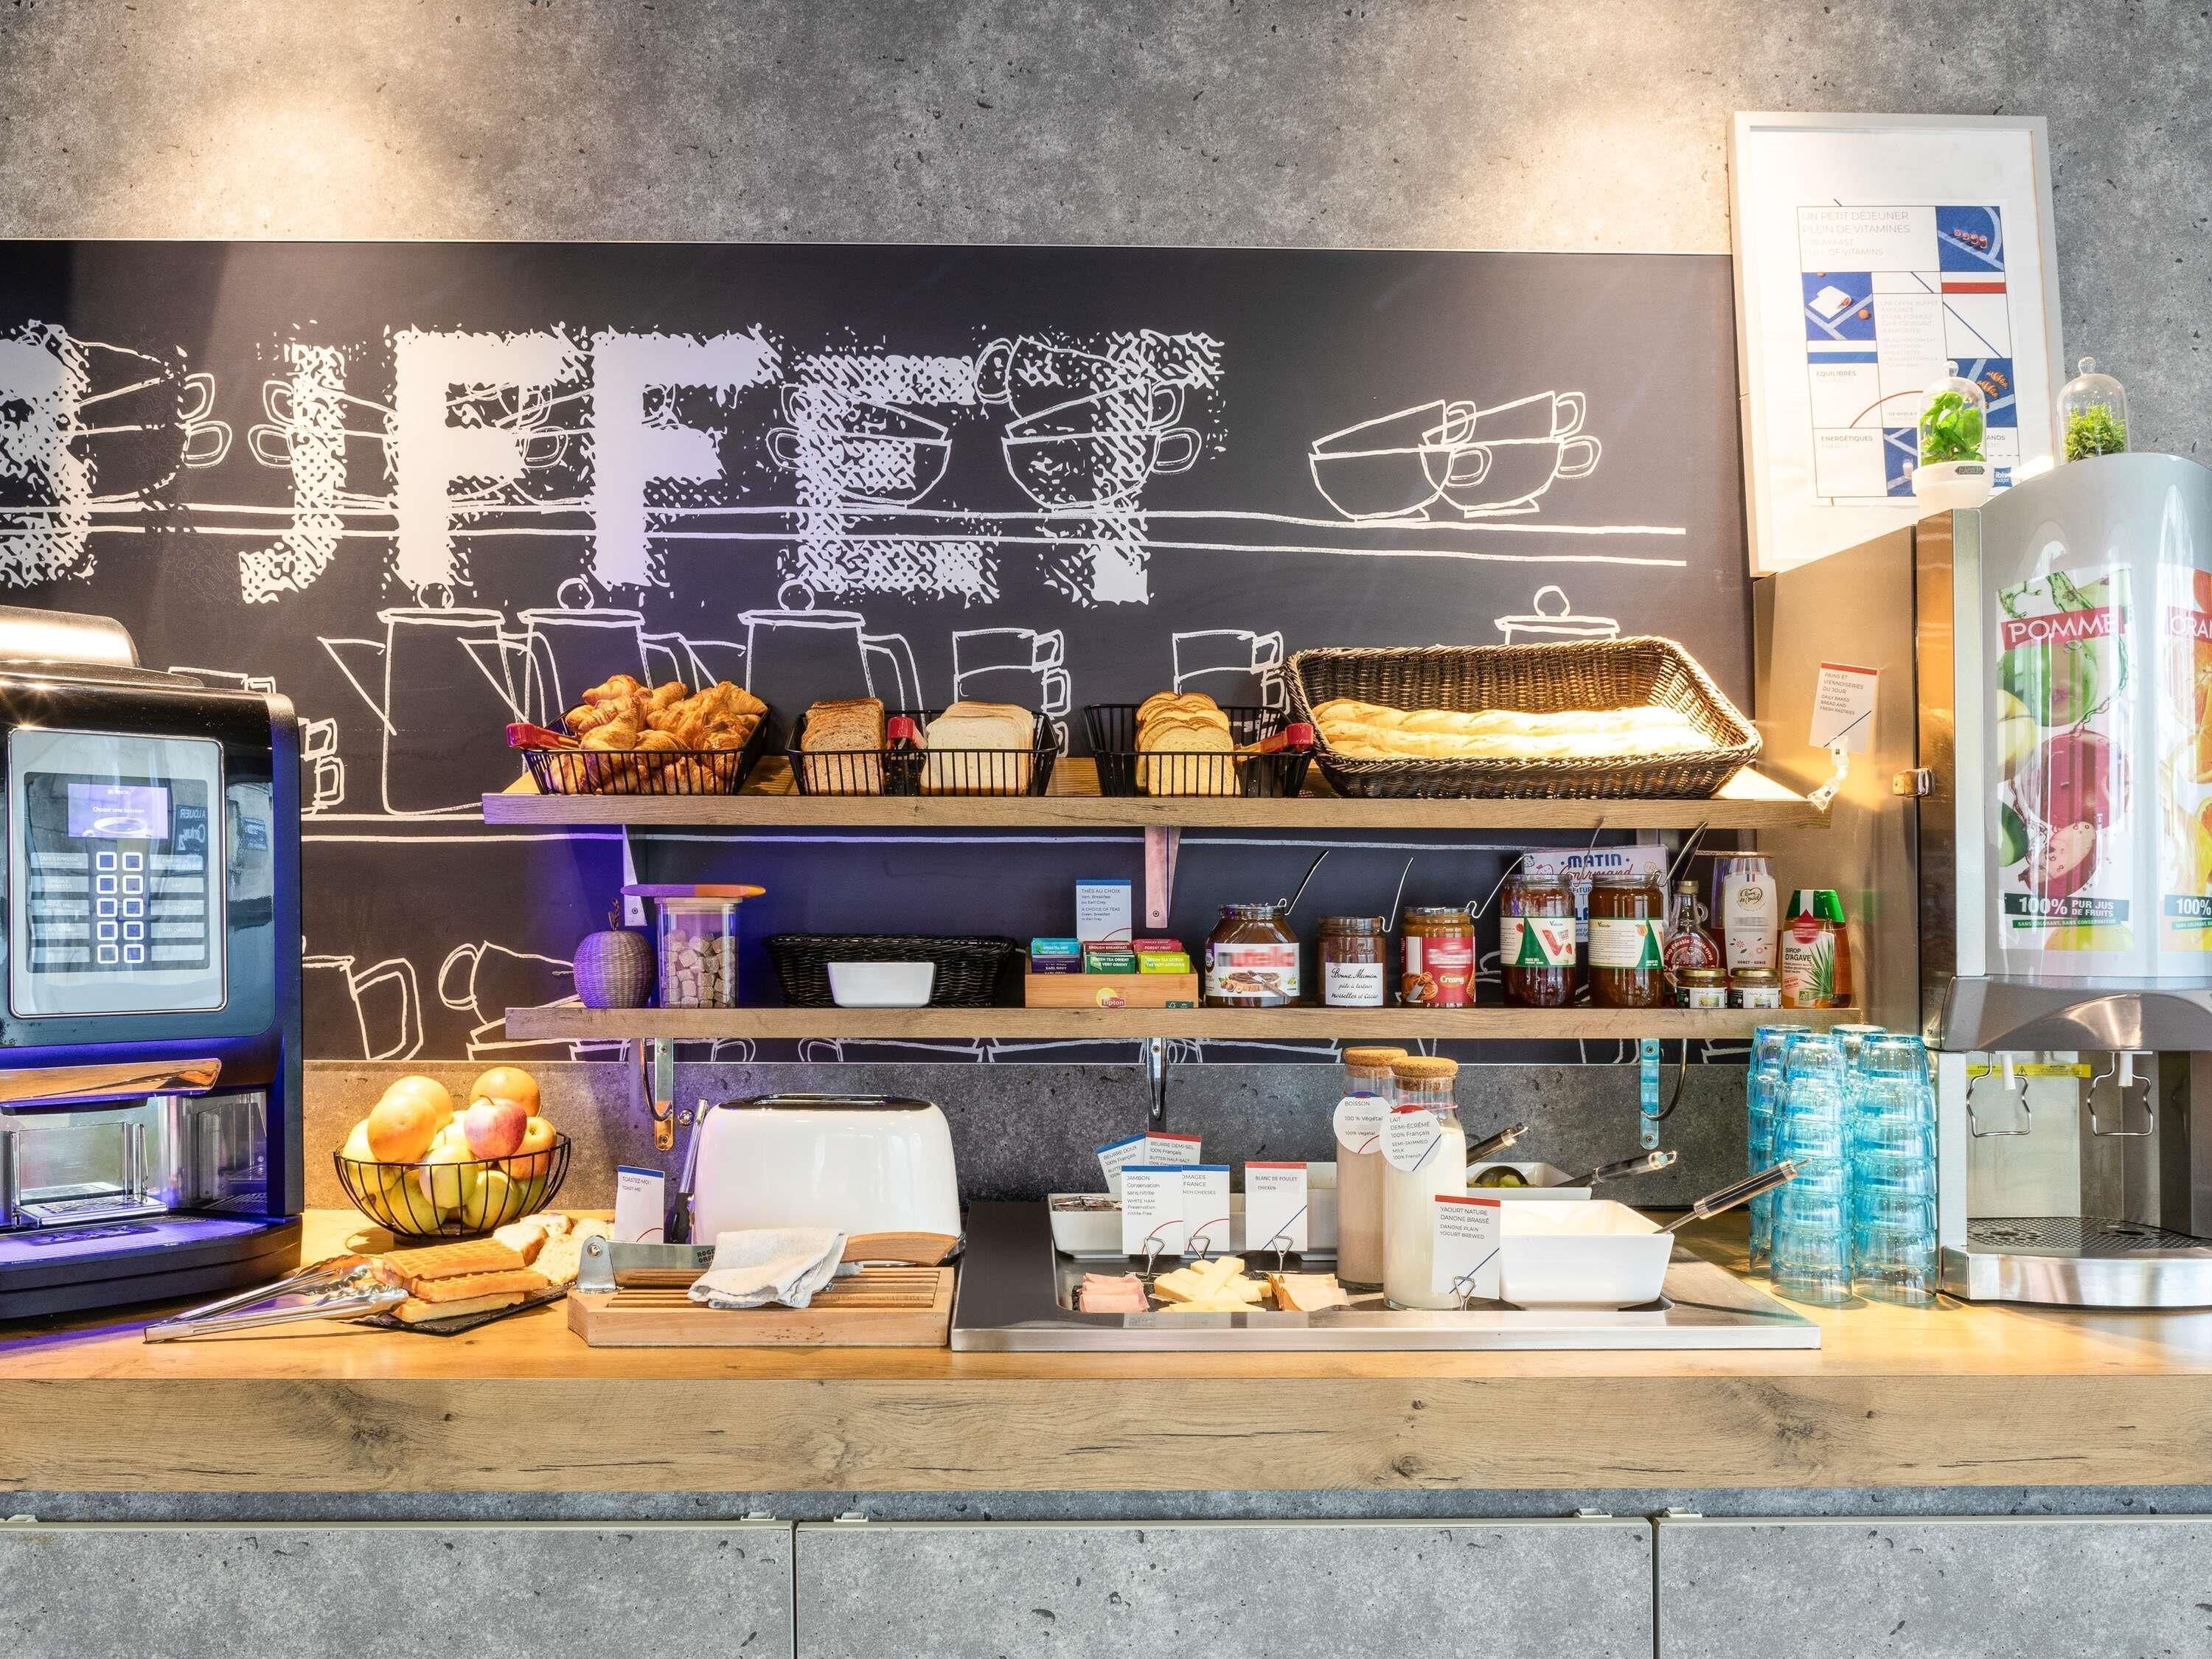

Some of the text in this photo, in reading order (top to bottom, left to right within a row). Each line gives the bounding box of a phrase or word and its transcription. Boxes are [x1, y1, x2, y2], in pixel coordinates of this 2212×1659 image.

[1820, 211, 1849, 221] PETIT
[1851, 209, 1909, 221] DÉJEUNER
[1804, 223, 1911, 234] PLEIN DE VITAMINES
[2008, 611, 2118, 644] POMME
[2171, 615, 2212, 640] ORA
[1568, 854, 1621, 868] MATIN
[2019, 897, 2114, 915] 100% PUR JUS
[2177, 898, 2211, 916] 100%
[2085, 909, 2114, 917] FRUITS
[1785, 953, 1812, 961] D'AGAVE
[1331, 967, 1377, 979] Bonne Maman
[1440, 975, 1464, 985] Creamy
[1102, 998, 1125, 1007] Lipton
[1361, 1115, 1383, 1123] Végétal
[1390, 1121, 1430, 1131] DEMI-ÉCRÉMÉ
[1406, 1130, 1430, 1138] Français
[1103, 1144, 1138, 1161] BEURRE DOUX
[1105, 1153, 1137, 1166] 100% Français
[1108, 1166, 1121, 1174] BUTT
[1440, 1214, 1490, 1224] DANONE BRASSÉ
[697, 1249, 714, 1258] ROGE
